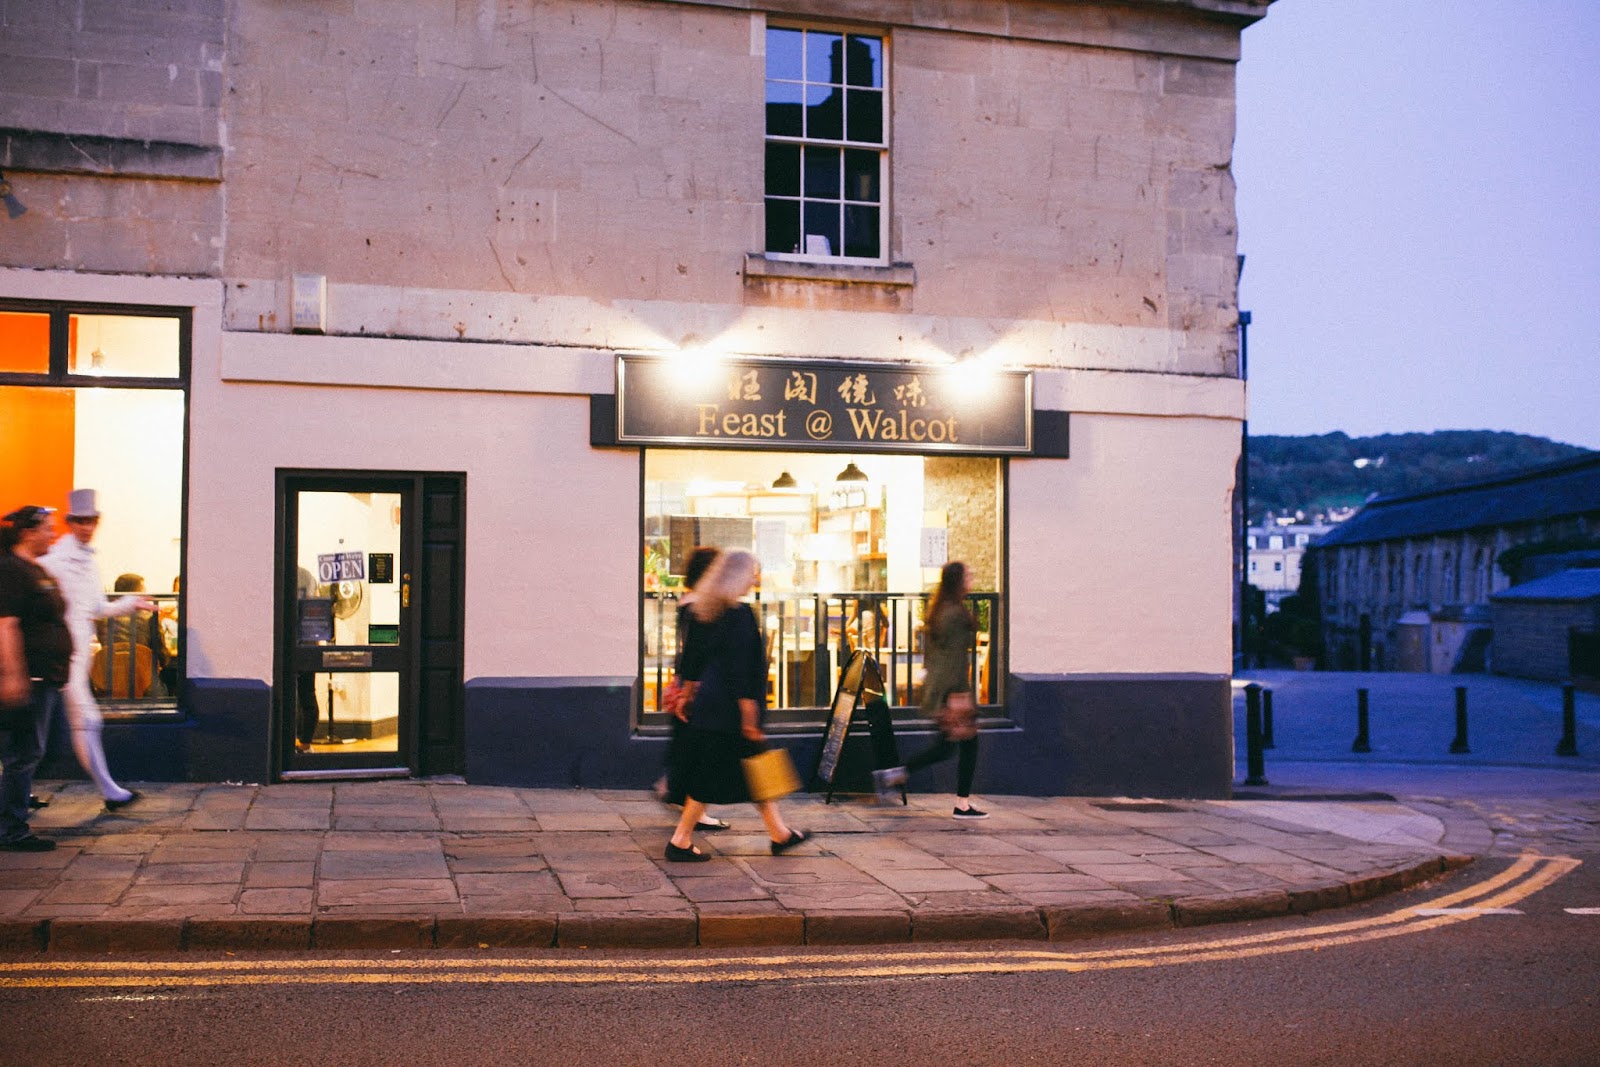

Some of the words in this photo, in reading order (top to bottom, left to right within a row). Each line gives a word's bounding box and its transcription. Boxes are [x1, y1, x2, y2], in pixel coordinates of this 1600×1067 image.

[695, 403, 787, 437] F.east
[805, 409, 833, 441] @
[846, 407, 959, 443] Walcot
[320, 559, 363, 581] OPEN
